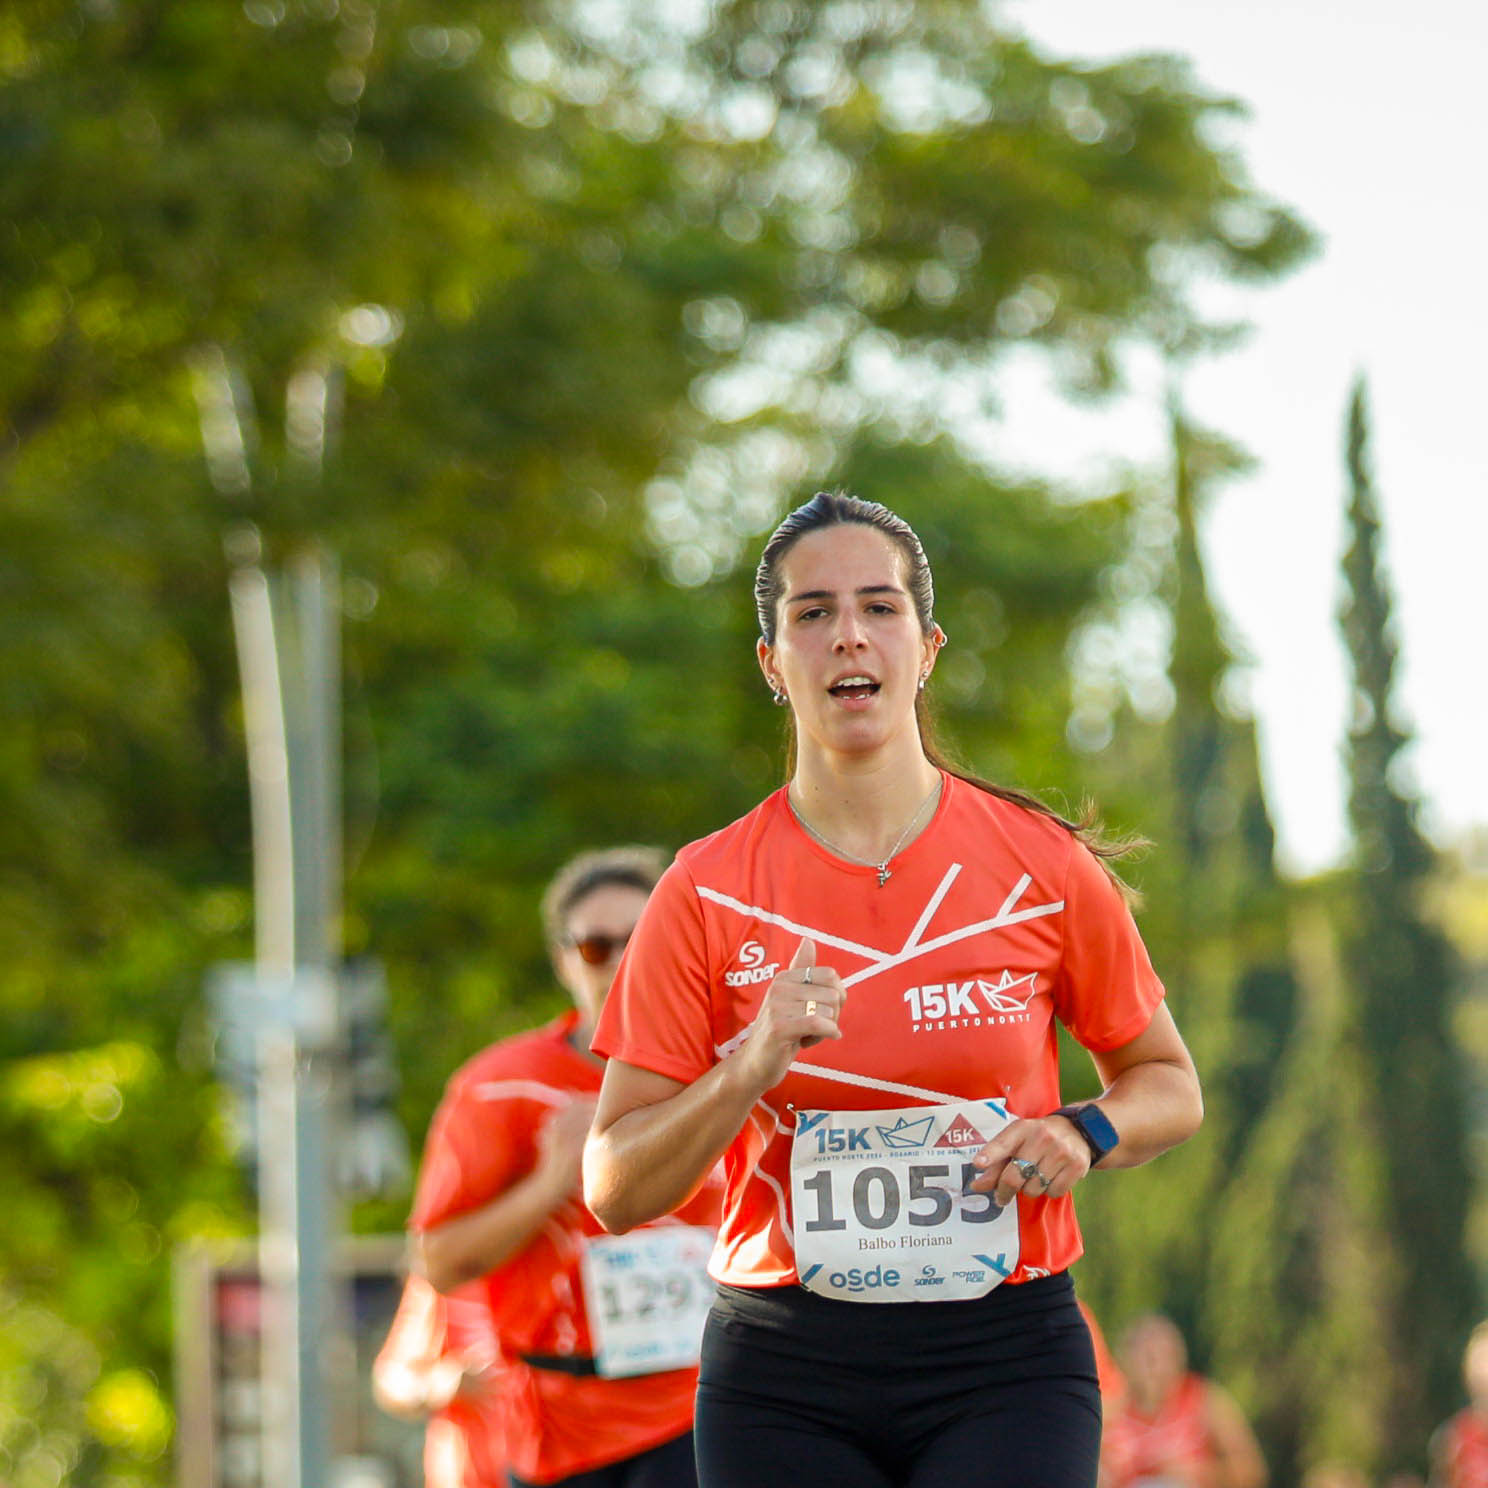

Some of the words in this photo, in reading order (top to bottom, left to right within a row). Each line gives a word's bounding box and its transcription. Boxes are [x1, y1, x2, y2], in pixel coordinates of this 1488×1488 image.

[903, 980, 981, 1022] 15K
[814, 1127, 872, 1154] 15K
[946, 1127, 976, 1145] 15K
[803, 1163, 1005, 1232] 1055
[858, 1236, 897, 1251] Balbo
[900, 1233, 953, 1248] Floriana
[828, 1264, 901, 1292] osde
